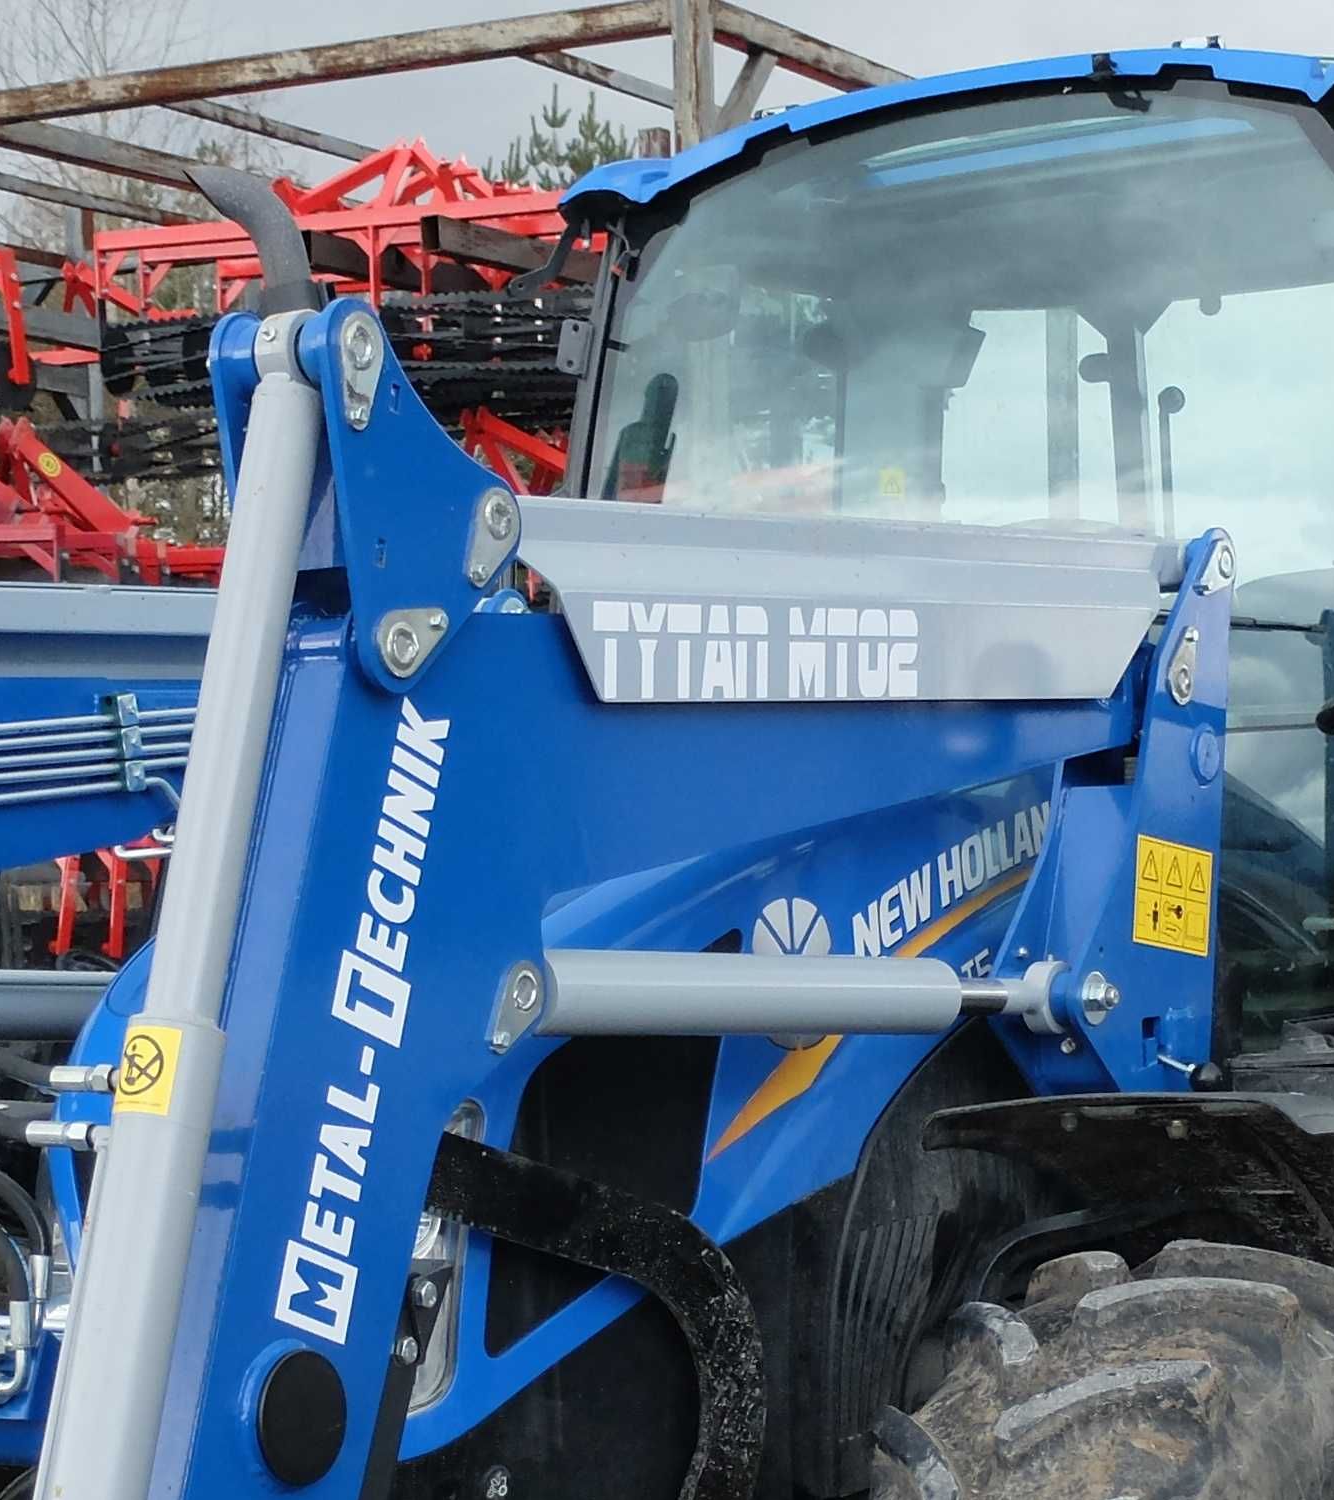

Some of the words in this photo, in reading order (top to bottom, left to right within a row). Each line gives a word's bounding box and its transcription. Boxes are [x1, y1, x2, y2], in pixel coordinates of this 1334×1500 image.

[593, 600, 769, 700] TYTAN
[851, 861, 932, 958] NEW
[936, 800, 1052, 909] HOLLAN
[275, 696, 451, 1346] METAL-TECHNIK
[960, 949, 992, 979] T5
